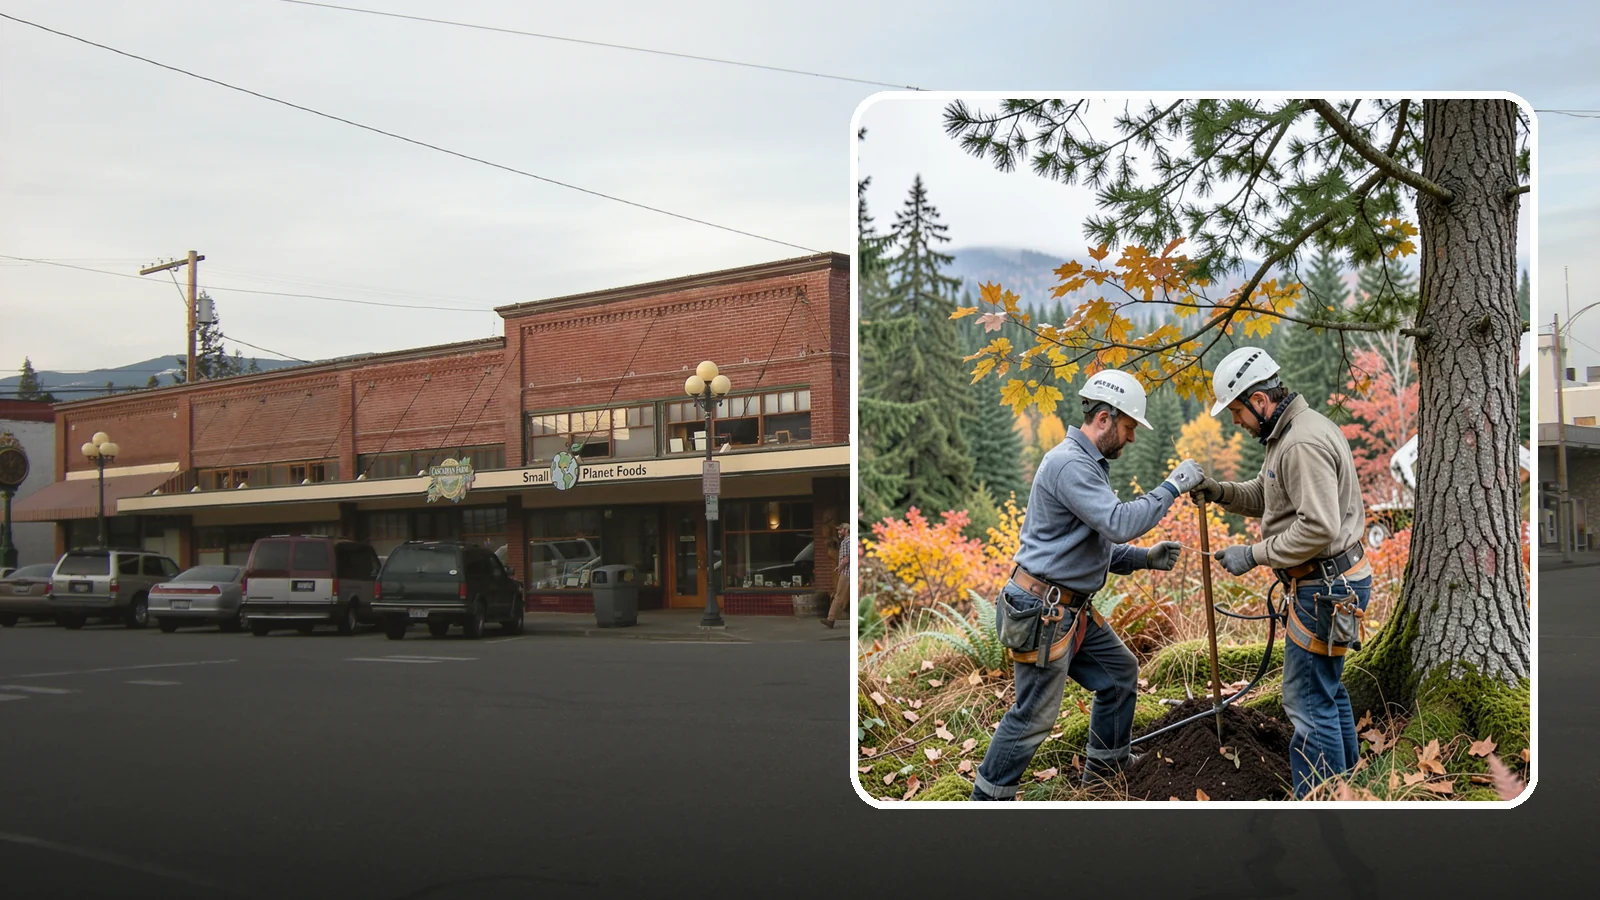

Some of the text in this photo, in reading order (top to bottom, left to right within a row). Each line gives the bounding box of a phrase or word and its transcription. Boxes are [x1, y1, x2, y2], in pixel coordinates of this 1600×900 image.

[523, 464, 647, 482] Small Planet Foods
